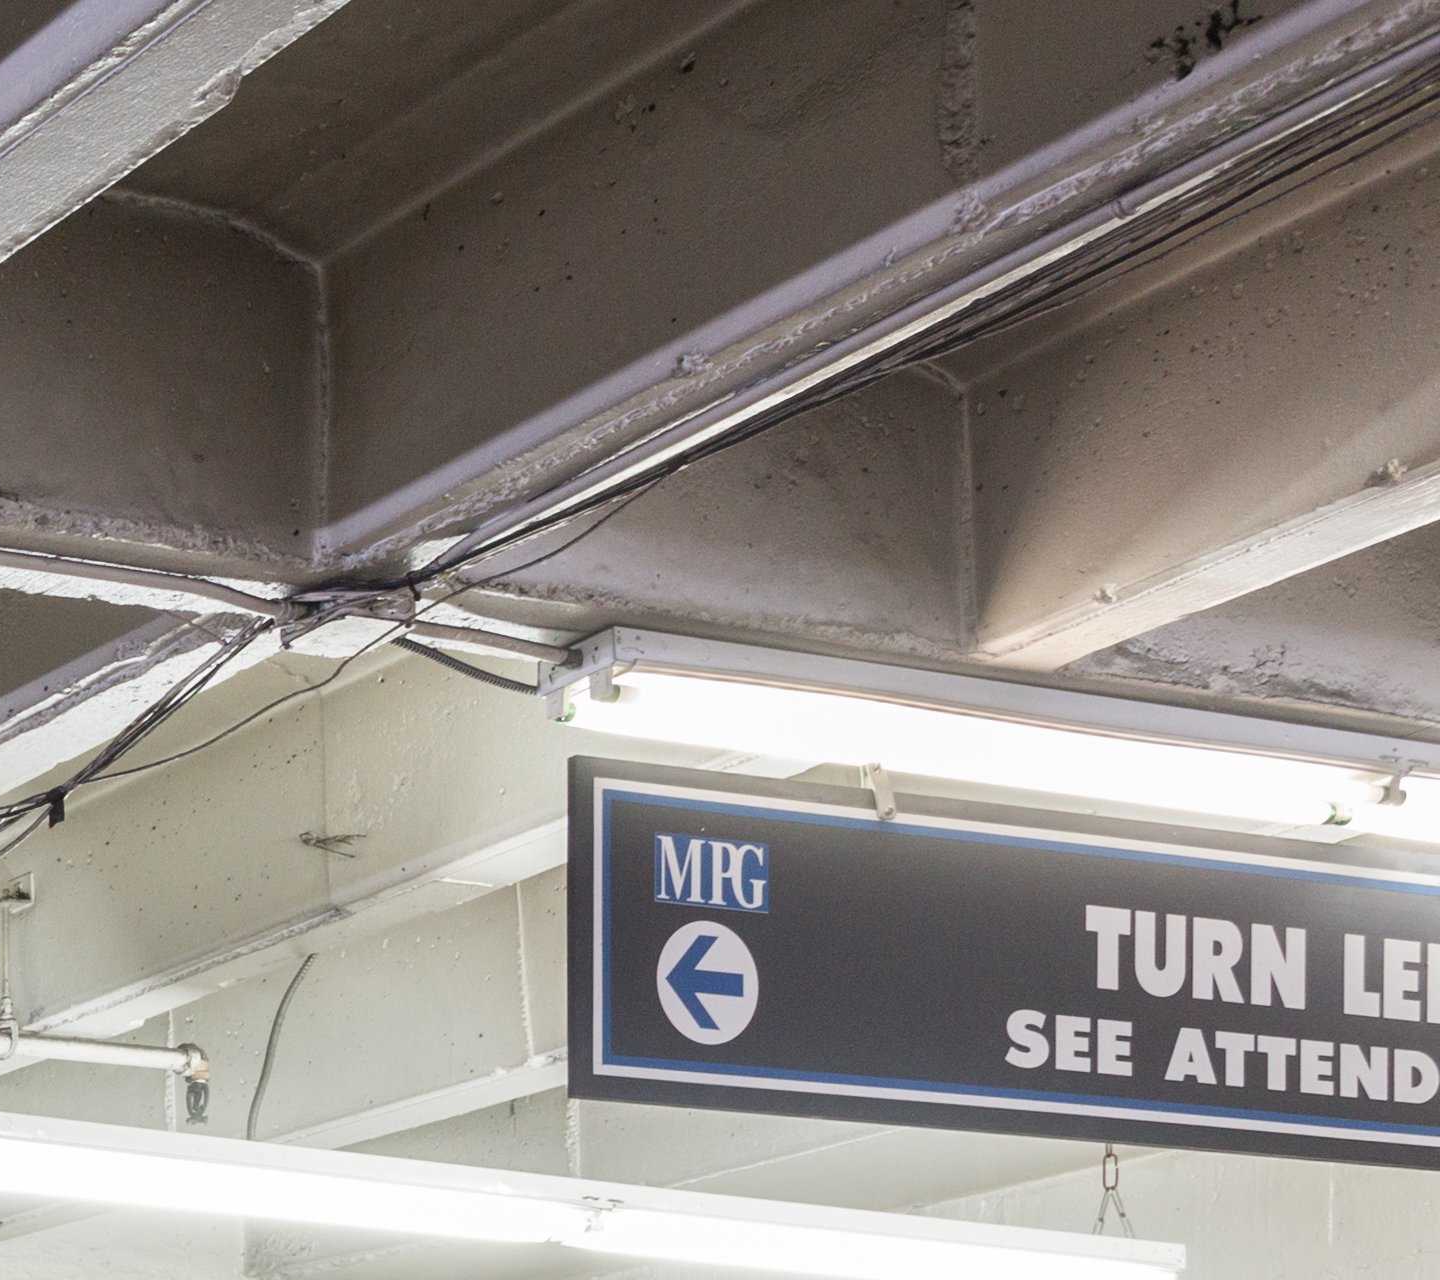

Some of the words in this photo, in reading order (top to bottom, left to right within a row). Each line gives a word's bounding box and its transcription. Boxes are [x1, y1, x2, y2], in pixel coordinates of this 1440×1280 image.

[657, 835, 767, 909] MPG
[1086, 904, 1306, 1010] TURN
[1005, 1010, 1133, 1077] SEE
